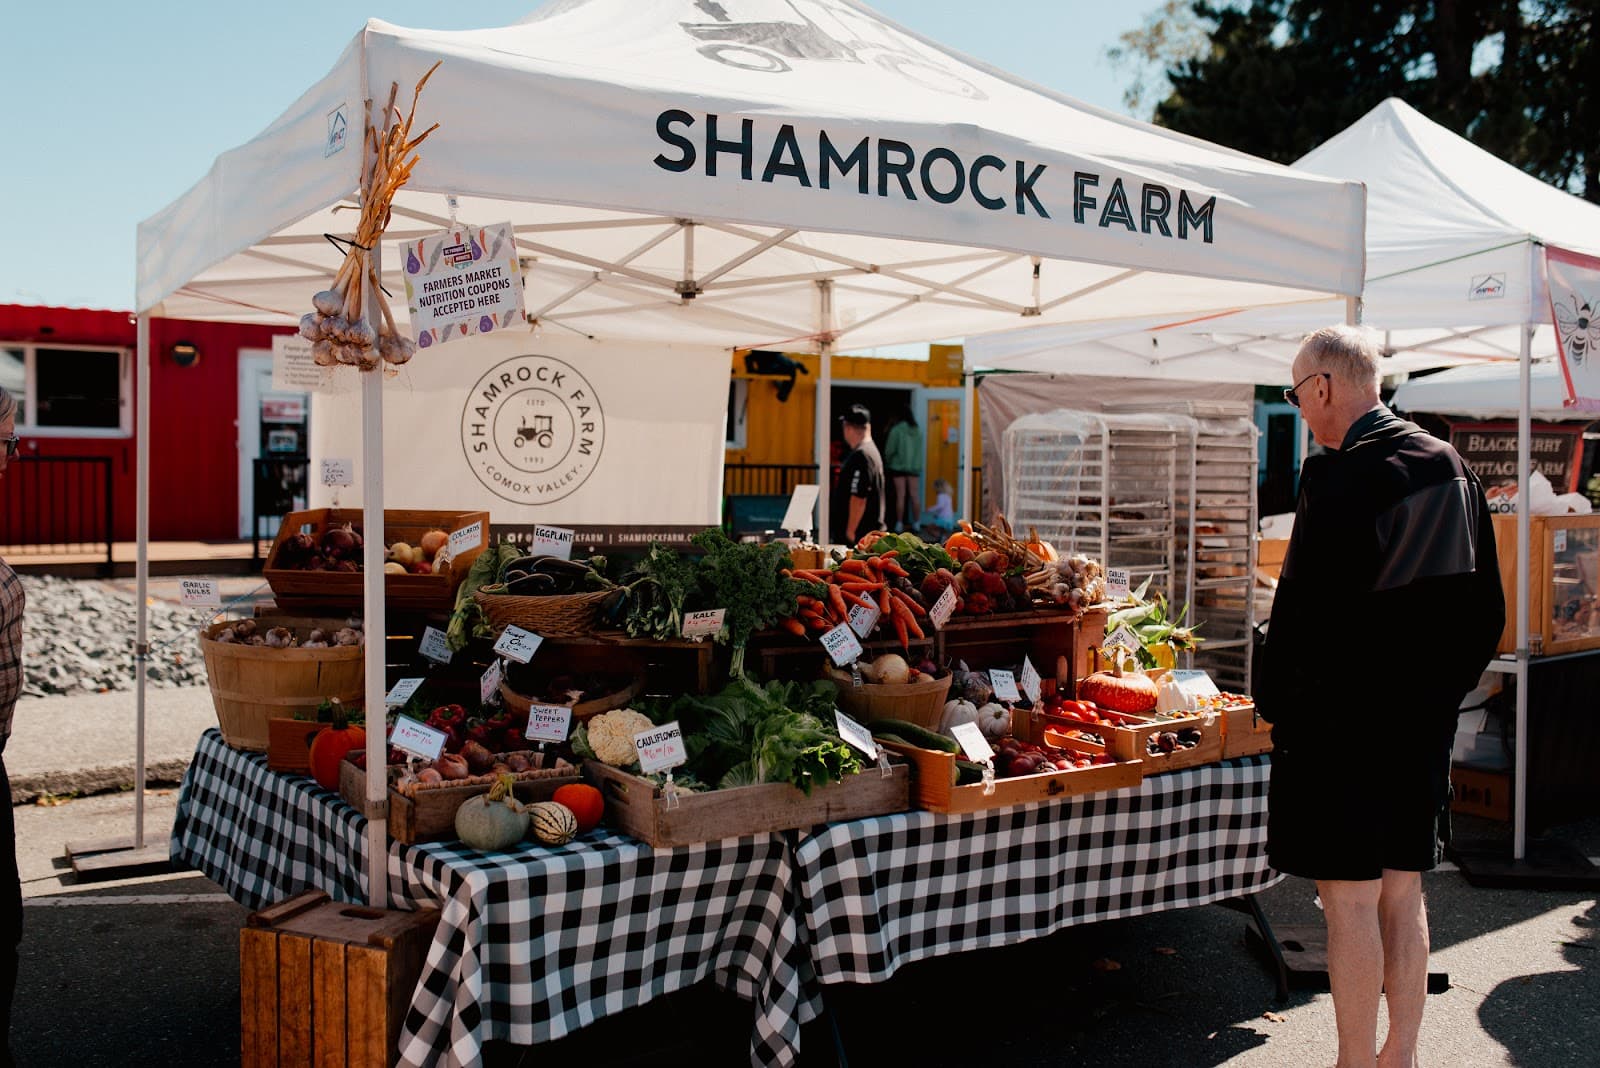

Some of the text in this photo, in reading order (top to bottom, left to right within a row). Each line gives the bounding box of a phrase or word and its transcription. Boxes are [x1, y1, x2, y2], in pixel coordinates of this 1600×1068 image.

[654, 109, 1217, 244] SHAMROCK FARM
[423, 267, 502, 293] FARMERS MARKET
[419, 279, 510, 308] NUTRITION COUPONS
[433, 299, 475, 318] ACCEPTED
[478, 293, 501, 307] HERE
[471, 366, 595, 456] SHAMROCK FARM
[486, 465, 579, 494] COMOX VALLEY
[535, 527, 573, 543] EGGPLANT
[183, 581, 210, 589] GARLIC
[692, 611, 717, 620] KALE
[533, 706, 558, 715] SWEET
[535, 714, 565, 723] PEPPERS
[636, 728, 681, 749] CAULIFLOWER
